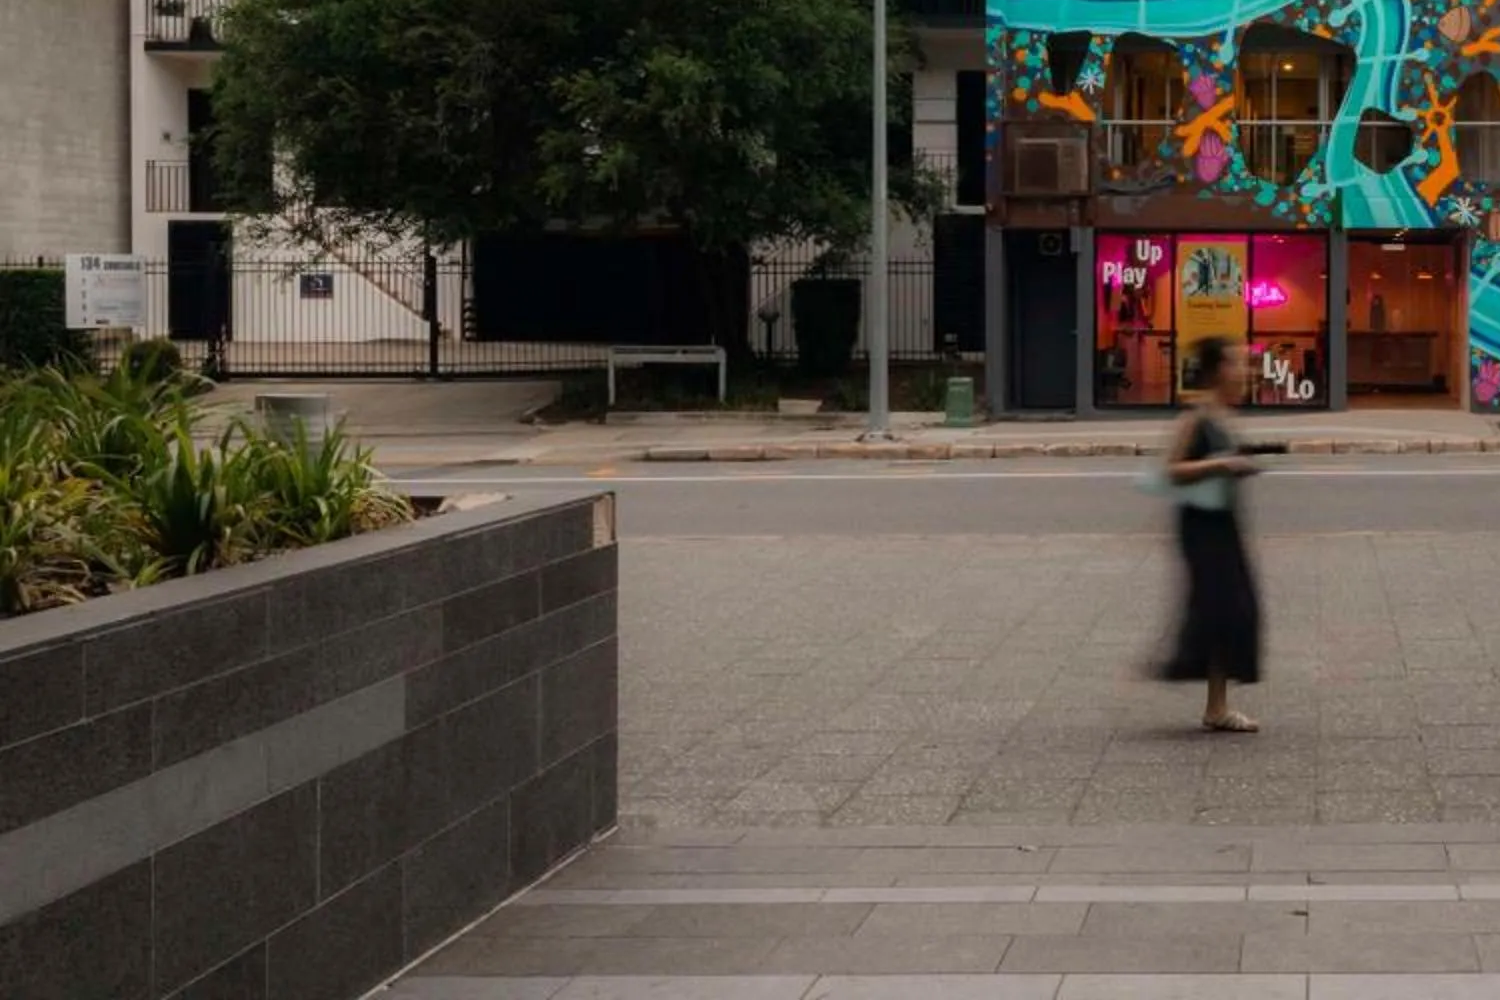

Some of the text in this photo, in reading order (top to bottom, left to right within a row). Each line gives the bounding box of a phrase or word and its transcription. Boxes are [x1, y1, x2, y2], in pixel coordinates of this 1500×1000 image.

[1136, 240, 1163, 265] Up
[1103, 262, 1147, 288] Play
[1263, 352, 1290, 384] Ly
[1287, 374, 1315, 399] Lo
